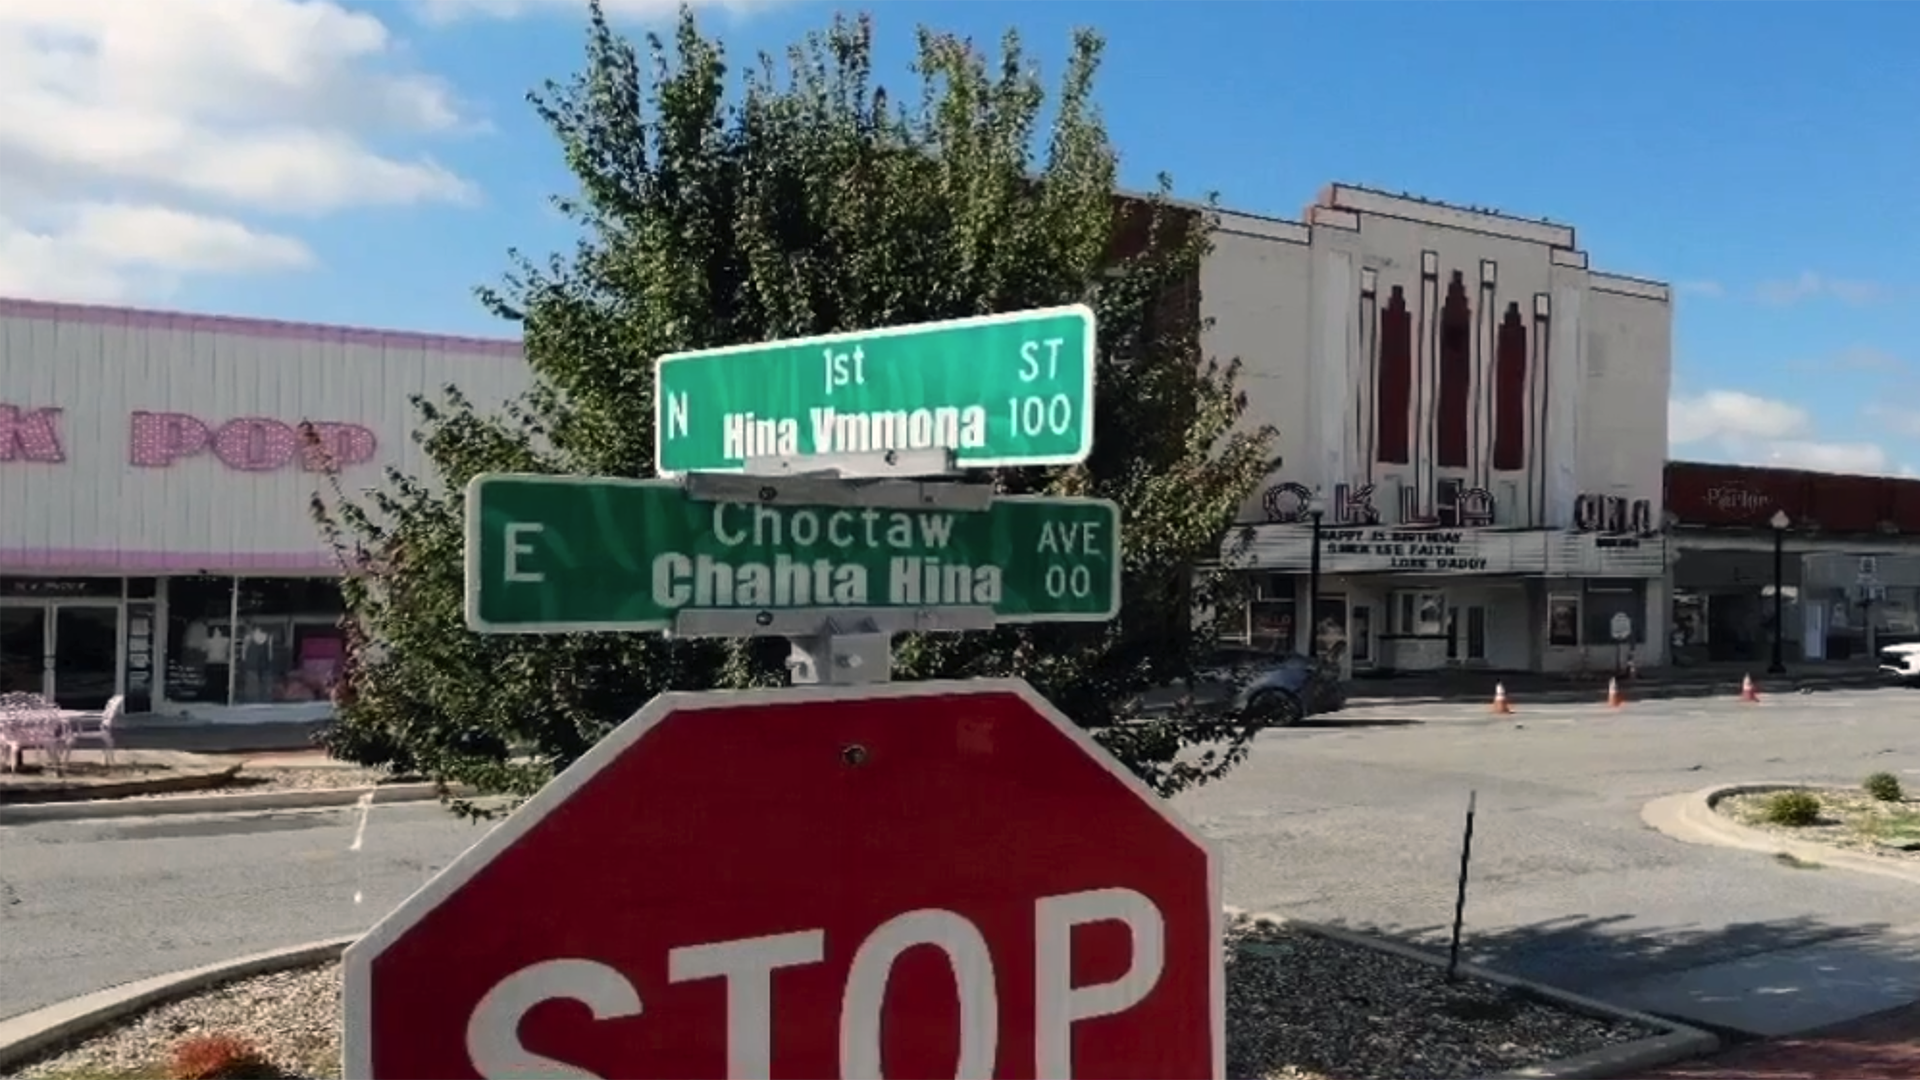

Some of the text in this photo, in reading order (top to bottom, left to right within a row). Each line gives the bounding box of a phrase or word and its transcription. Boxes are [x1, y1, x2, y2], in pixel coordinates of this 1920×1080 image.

[822, 345, 866, 395] 1st
[1018, 338, 1064, 383] ST
[667, 391, 689, 440] N
[722, 404, 986, 460] Hina Vmmona
[1008, 393, 1072, 438] 100
[130, 410, 377, 473] POP
[712, 502, 954, 549] Choctaw
[1263, 482, 1495, 528] OKLA
[504, 522, 546, 583] E
[1037, 521, 1102, 557] AVE
[651, 552, 1003, 608] Chahta Hina
[1044, 564, 1092, 599] 00
